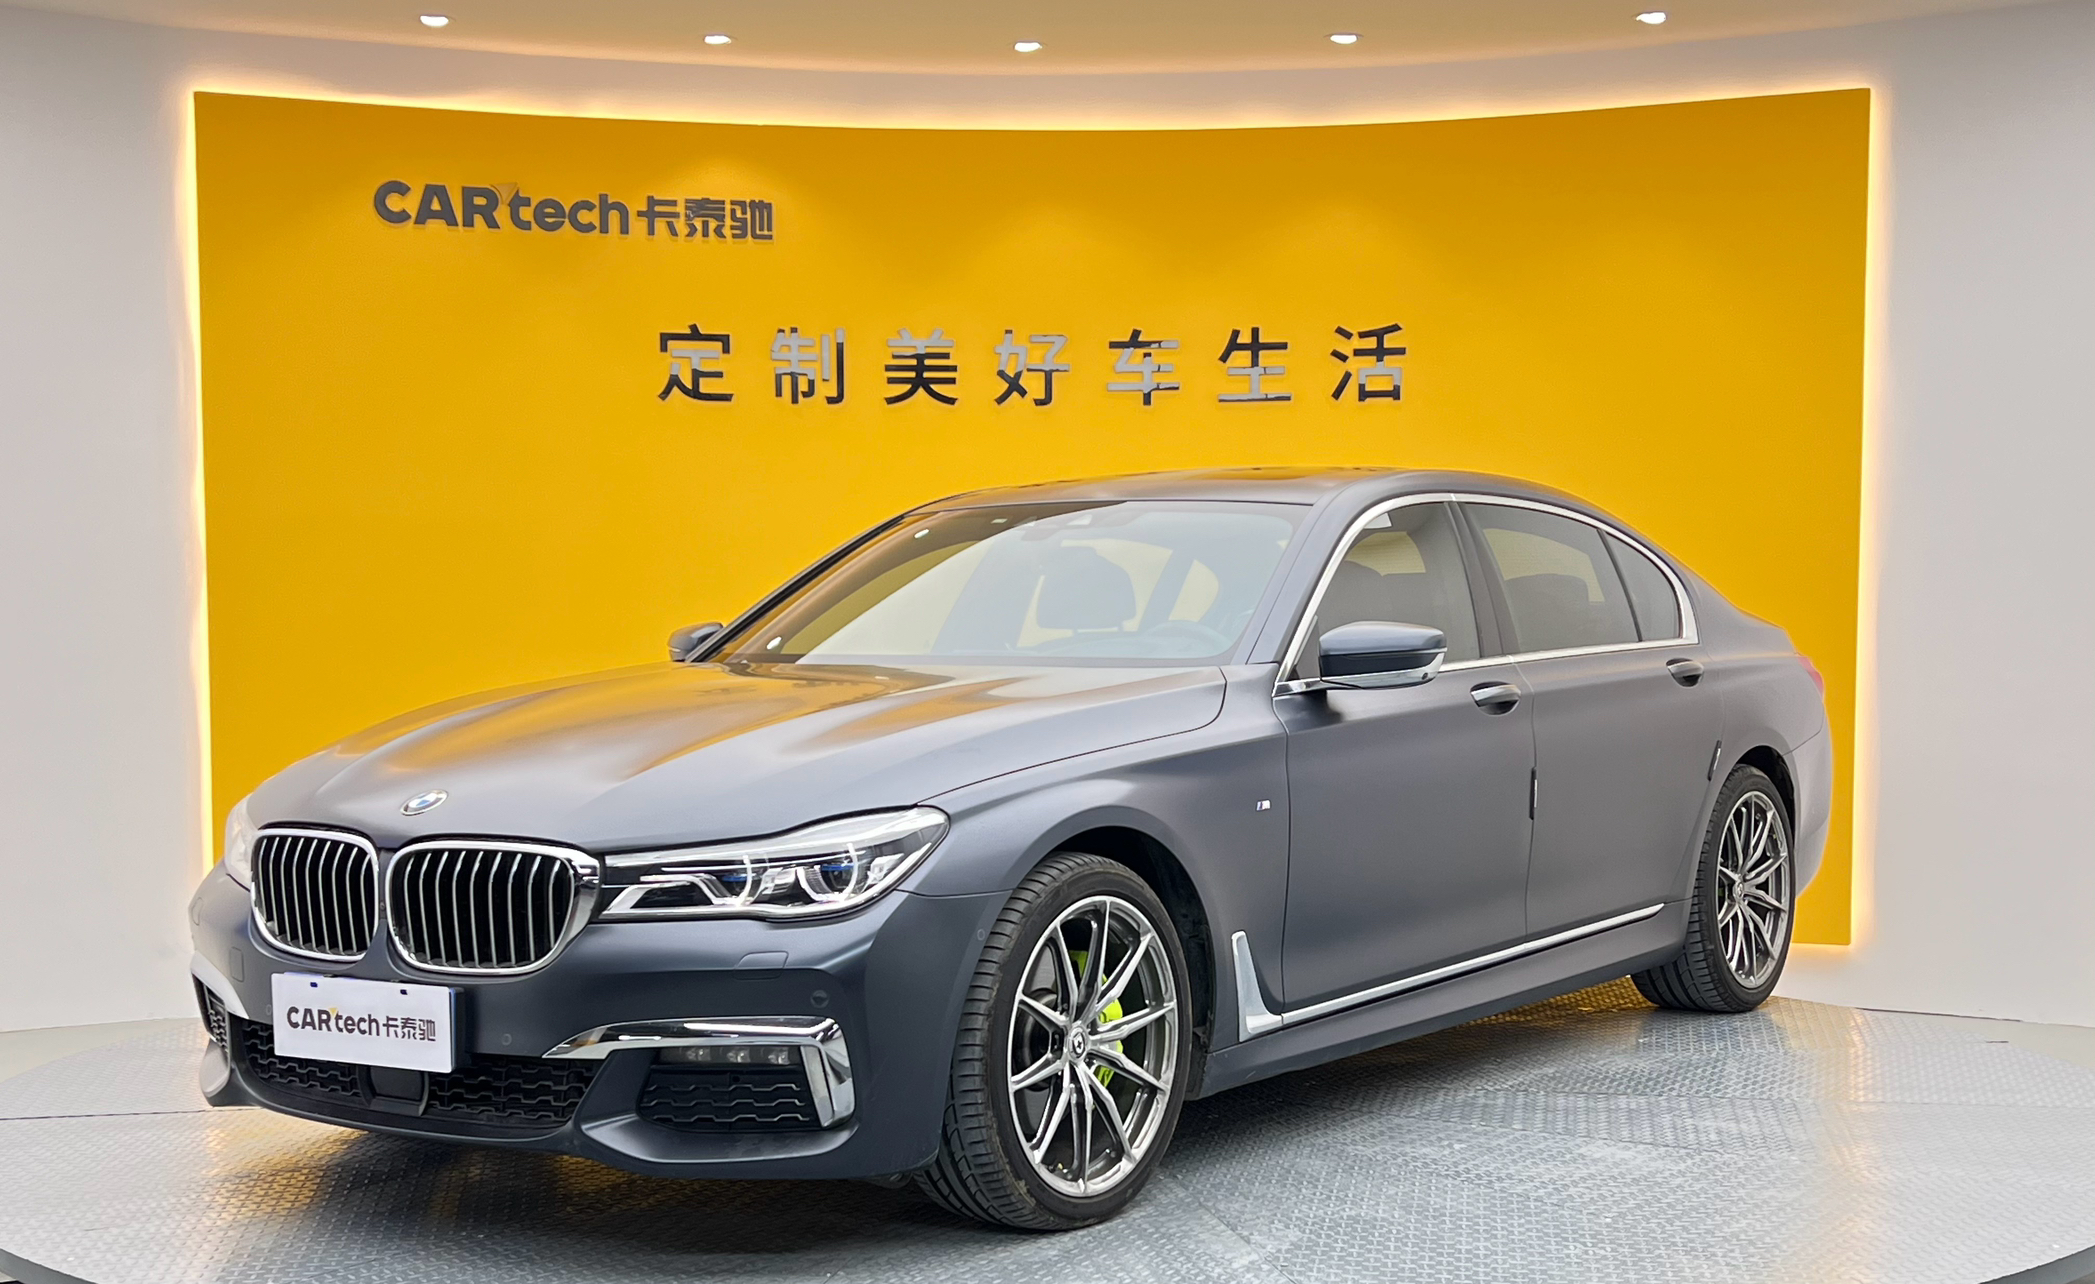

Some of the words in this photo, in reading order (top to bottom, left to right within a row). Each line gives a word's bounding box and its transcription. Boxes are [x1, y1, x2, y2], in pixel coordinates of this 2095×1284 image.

[373, 179, 630, 236] CARtech
[636, 195, 774, 241] 卡泰驰
[657, 323, 1407, 406] 定制美好车生活
[286, 1006, 380, 1037] CARtech
[382, 1015, 436, 1042] 卡泰驰
